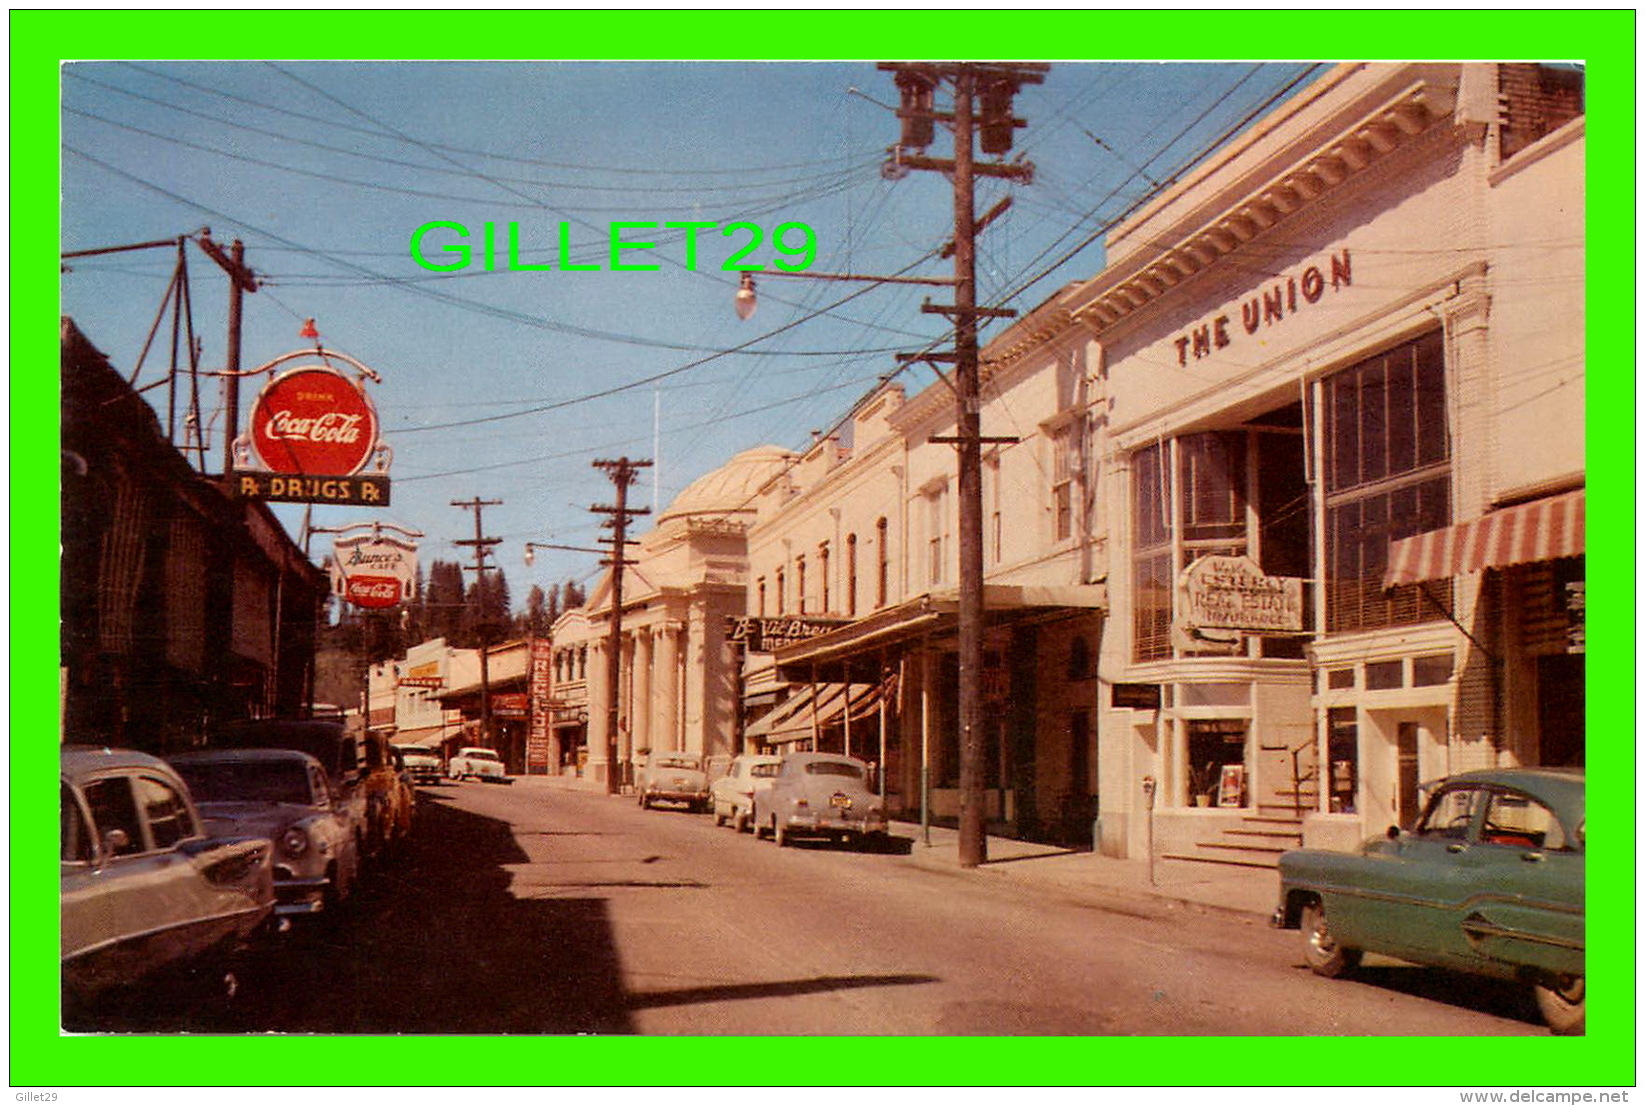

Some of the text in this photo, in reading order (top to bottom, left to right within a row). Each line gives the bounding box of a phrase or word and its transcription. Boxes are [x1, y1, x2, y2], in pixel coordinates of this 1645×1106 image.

[1174, 248, 1352, 368] THE UNION
[296, 391, 335, 401] DRINK
[265, 410, 363, 444] Coca-Cola
[271, 478, 350, 499] DRUGS
